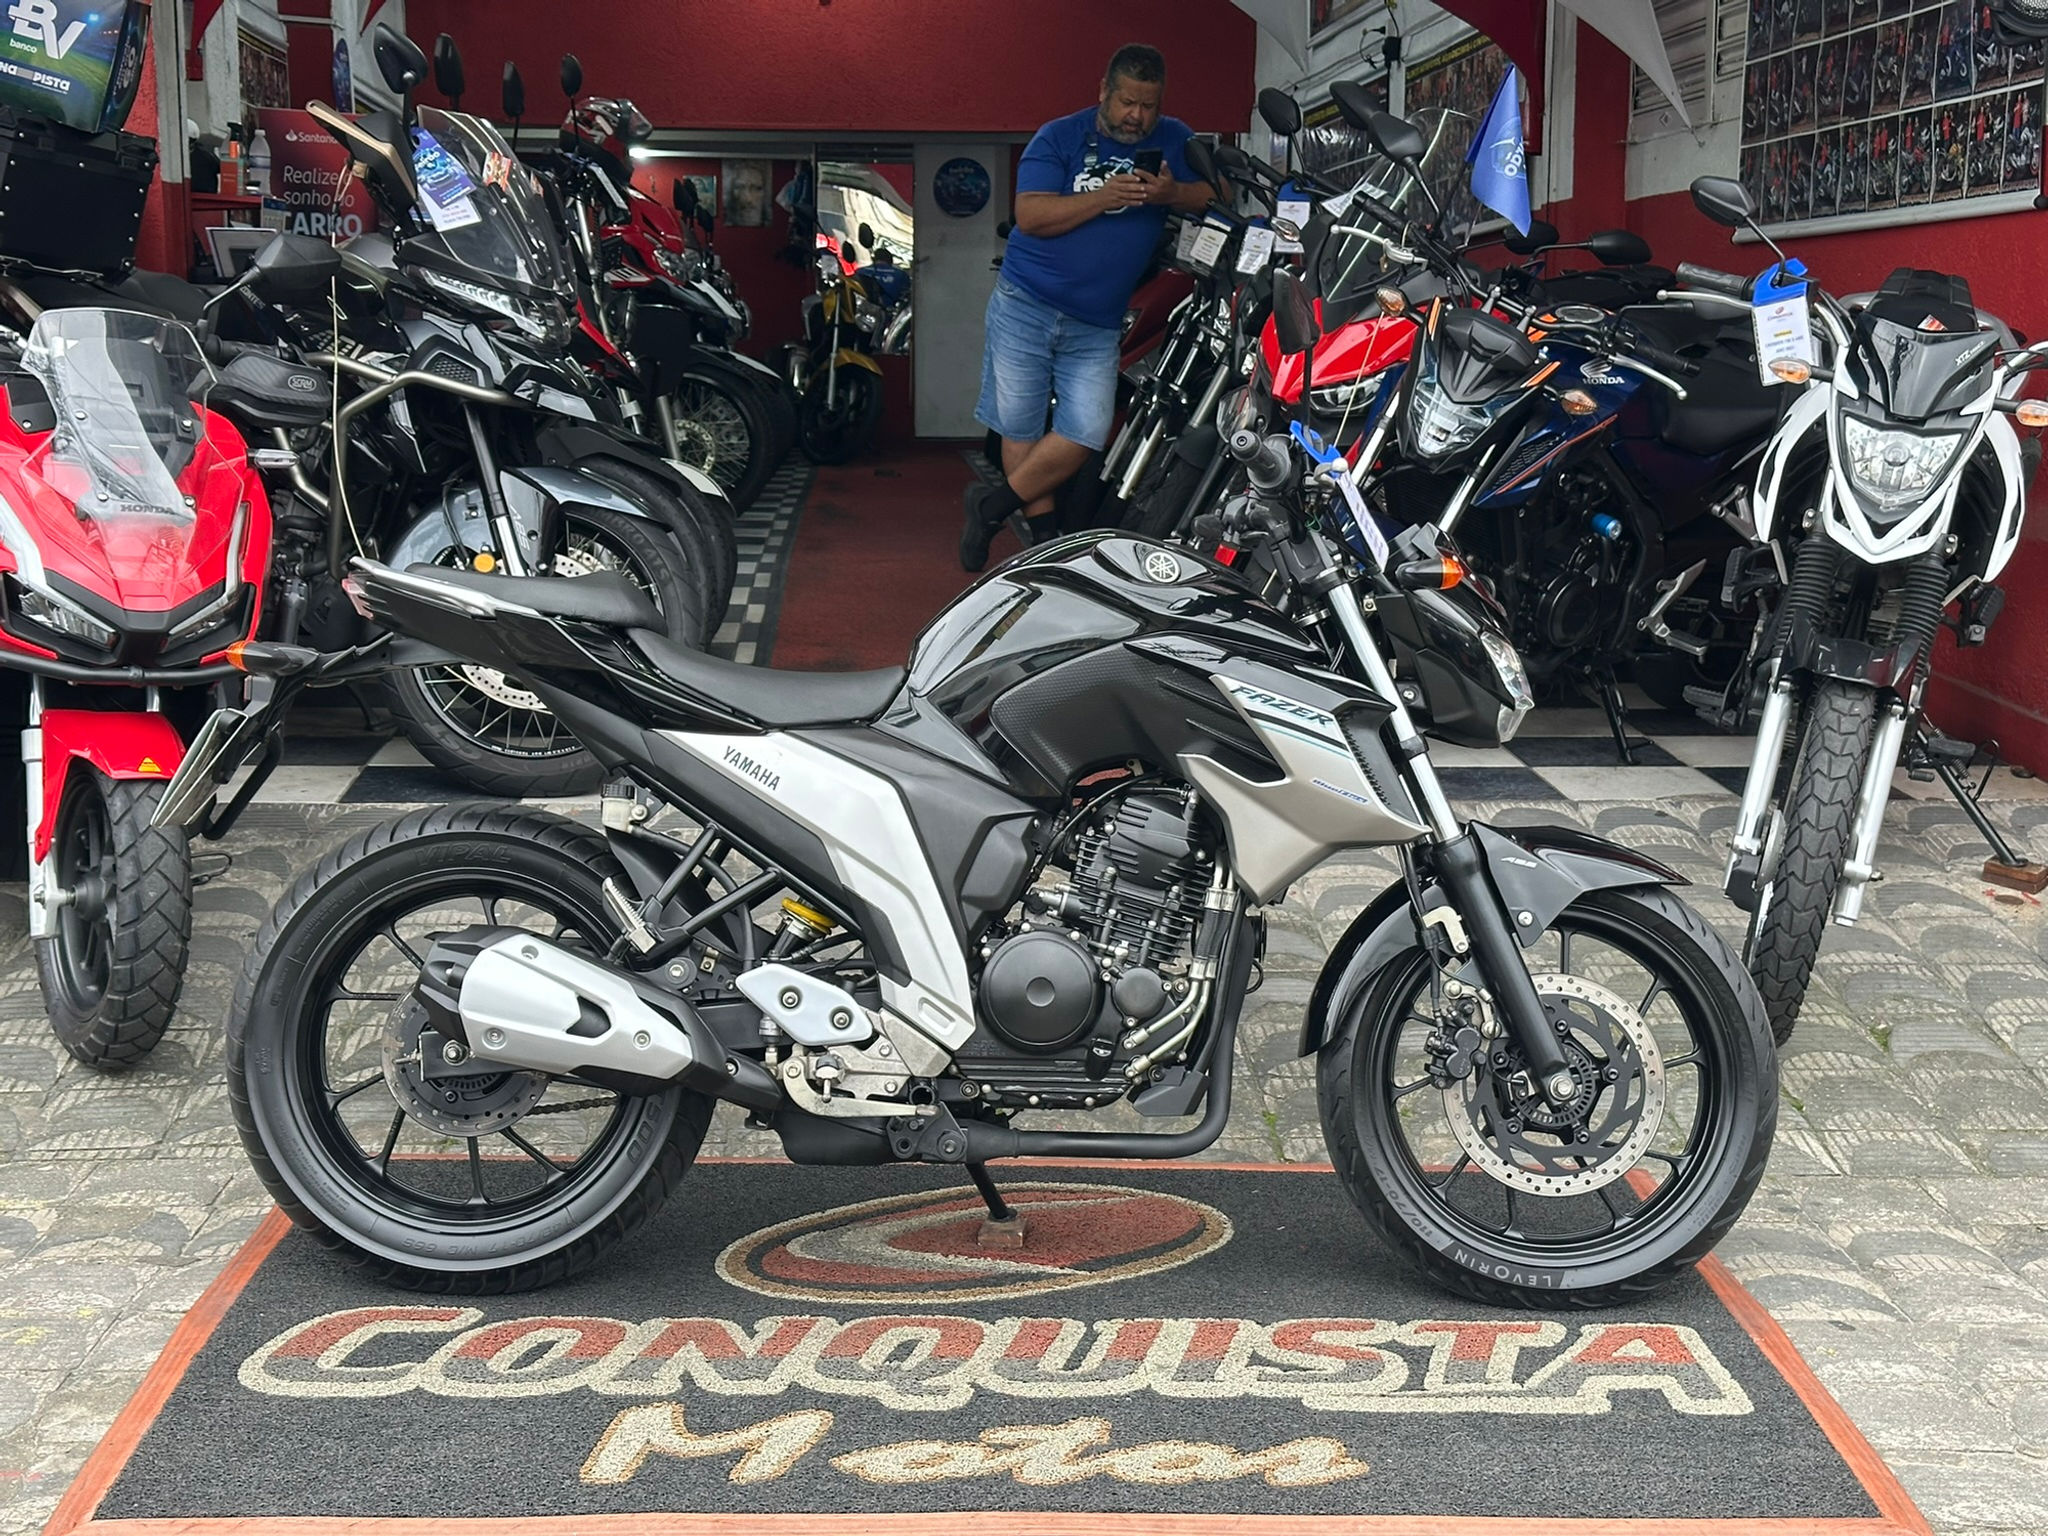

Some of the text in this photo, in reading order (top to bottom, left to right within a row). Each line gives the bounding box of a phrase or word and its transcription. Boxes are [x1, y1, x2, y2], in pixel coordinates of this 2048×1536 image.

[9, 38, 38, 54] banco
[298, 131, 339, 144] Santan
[284, 165, 339, 186] Realize
[284, 189, 332, 207] sonho
[1582, 376, 1626, 385] HONDA
[120, 504, 176, 515] HONDA
[1230, 685, 1335, 728] FAZER
[722, 745, 782, 791] YAMAHA
[414, 841, 512, 866] VIPAL
[1454, 1248, 1552, 1288] LEVORIN
[237, 1305, 1756, 1417] CONQUISTA
